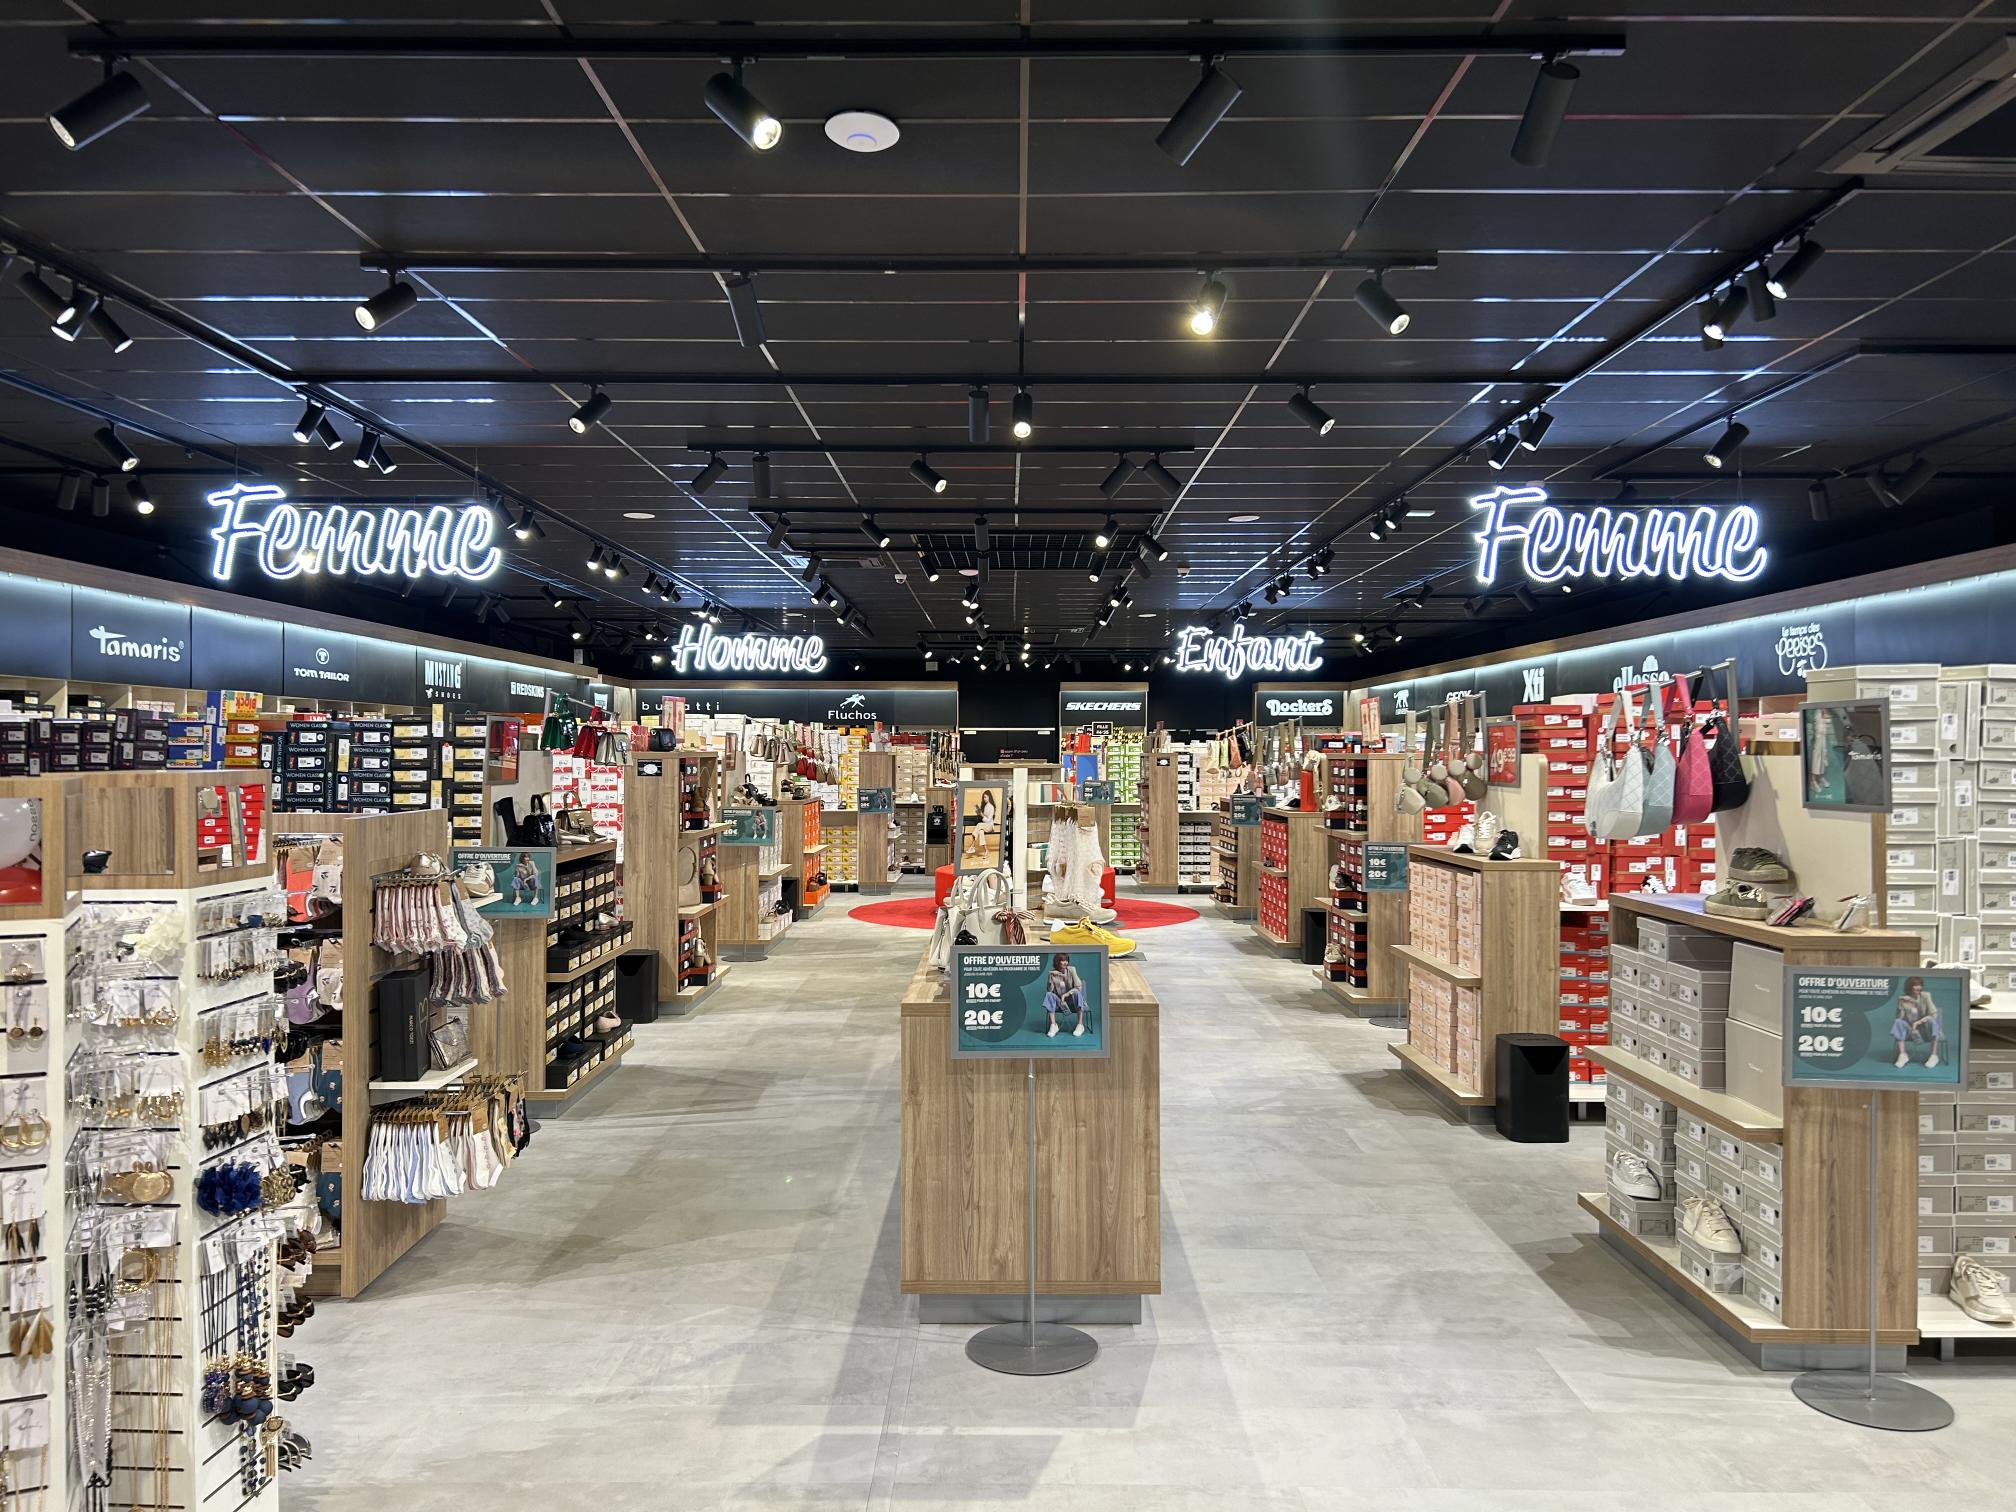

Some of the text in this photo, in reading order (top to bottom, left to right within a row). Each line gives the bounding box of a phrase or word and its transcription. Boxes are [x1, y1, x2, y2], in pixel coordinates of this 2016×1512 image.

[207, 481, 503, 582] Femme
[1470, 485, 1770, 586] Femme
[670, 622, 827, 674] Homme
[1174, 622, 1325, 681] Enfant
[318, 670, 350, 683] TAILOR
[435, 690, 461, 700] SHOES
[516, 681, 545, 699] REDSKINS
[641, 701, 720, 711] buatti
[1065, 702, 1142, 711] SKECHERS
[828, 710, 877, 720] Fluchos
[1369, 858, 1386, 866] 10€
[1368, 870, 1388, 878] 20€
[963, 955, 1040, 966] OFFRE D'OUVERTURE
[966, 982, 1001, 999] 10€
[1798, 977, 1889, 989] OFFRE D'OUVERTURE
[964, 1009, 1004, 1026] 20€
[1800, 1006, 1843, 1023] 10€
[1798, 1035, 1845, 1052] 20€
